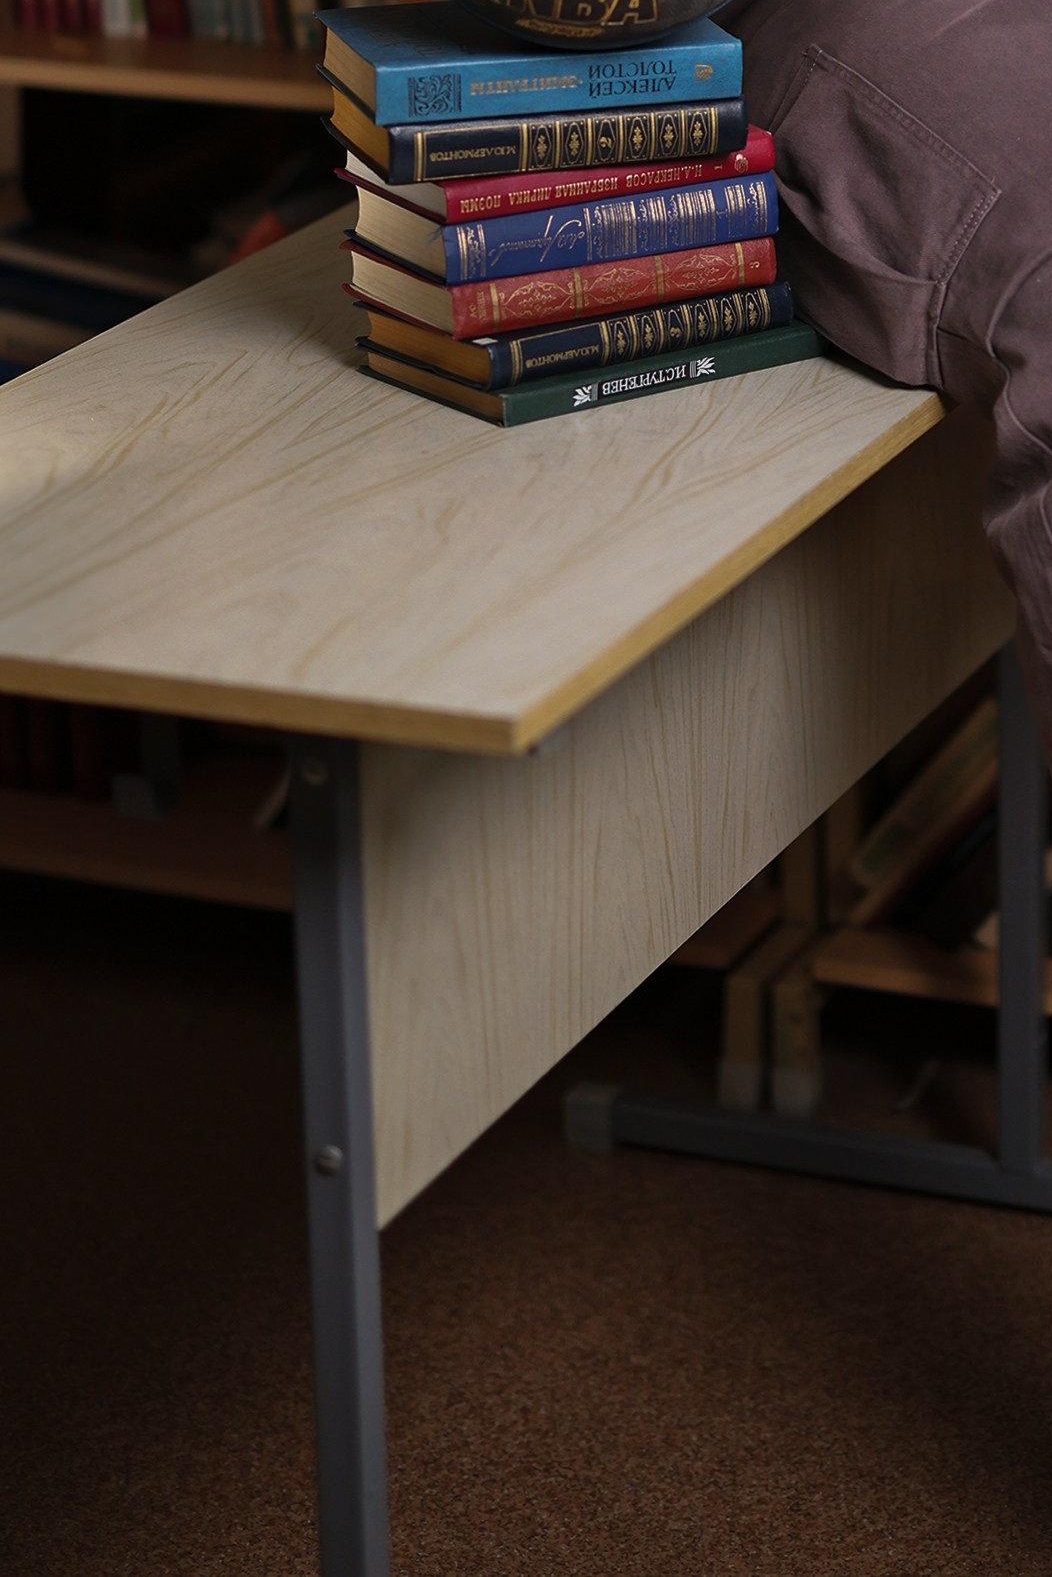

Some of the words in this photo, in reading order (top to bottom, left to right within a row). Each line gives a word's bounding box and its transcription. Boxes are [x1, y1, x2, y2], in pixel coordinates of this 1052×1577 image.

[586, 59, 674, 81] ТОЛСТОЙ
[468, 74, 578, 95] ЭМИГРАНТЫ
[587, 75, 677, 97] АЛЕКСЕЙ
[600, 135, 611, 148] 2
[507, 186, 553, 205] ЛИРИКА
[554, 176, 619, 198] ИЗБРАННАЯ
[459, 194, 501, 213] ПОЭМЫ
[670, 326, 681, 338] 3
